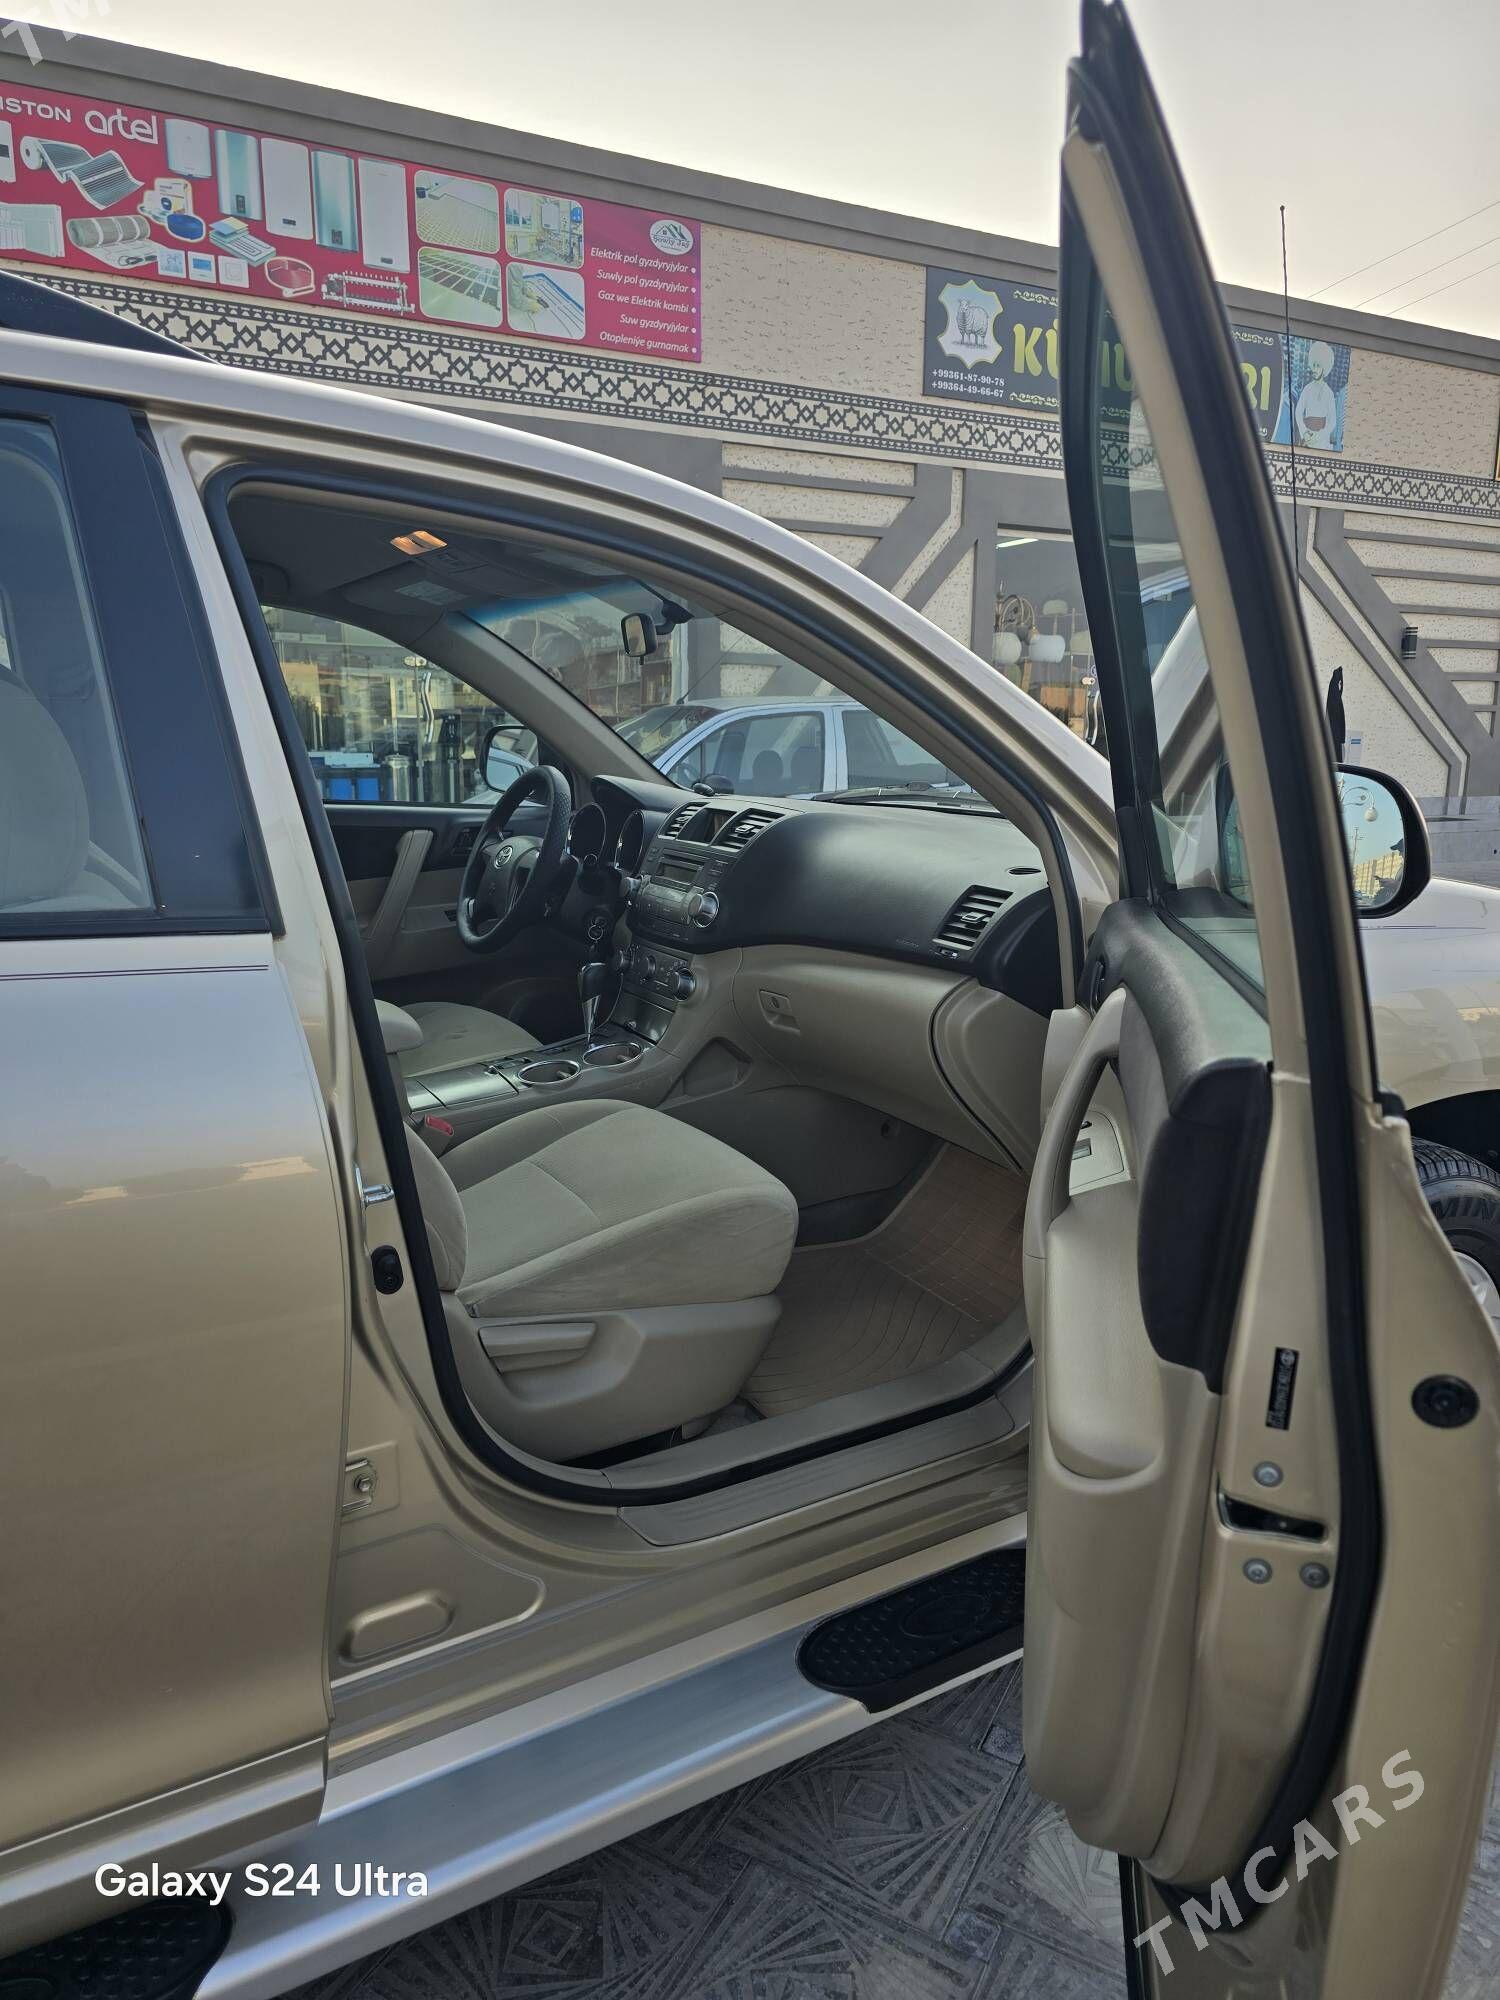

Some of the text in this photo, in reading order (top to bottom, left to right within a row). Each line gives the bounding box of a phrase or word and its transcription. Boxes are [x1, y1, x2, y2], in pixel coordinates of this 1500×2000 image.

[84, 108, 159, 144] artel
[590, 247, 622, 261] Elektrik
[623, 254, 638, 264] pol
[596, 269, 623, 284] Suwly
[623, 275, 638, 285] pol
[598, 289, 689, 313] Gaz we Elektrik kombi
[620, 314, 638, 325] Suw
[646, 340, 689, 353] gurnamak
[932, 368, 1005, 387] +99361-87-90-78
